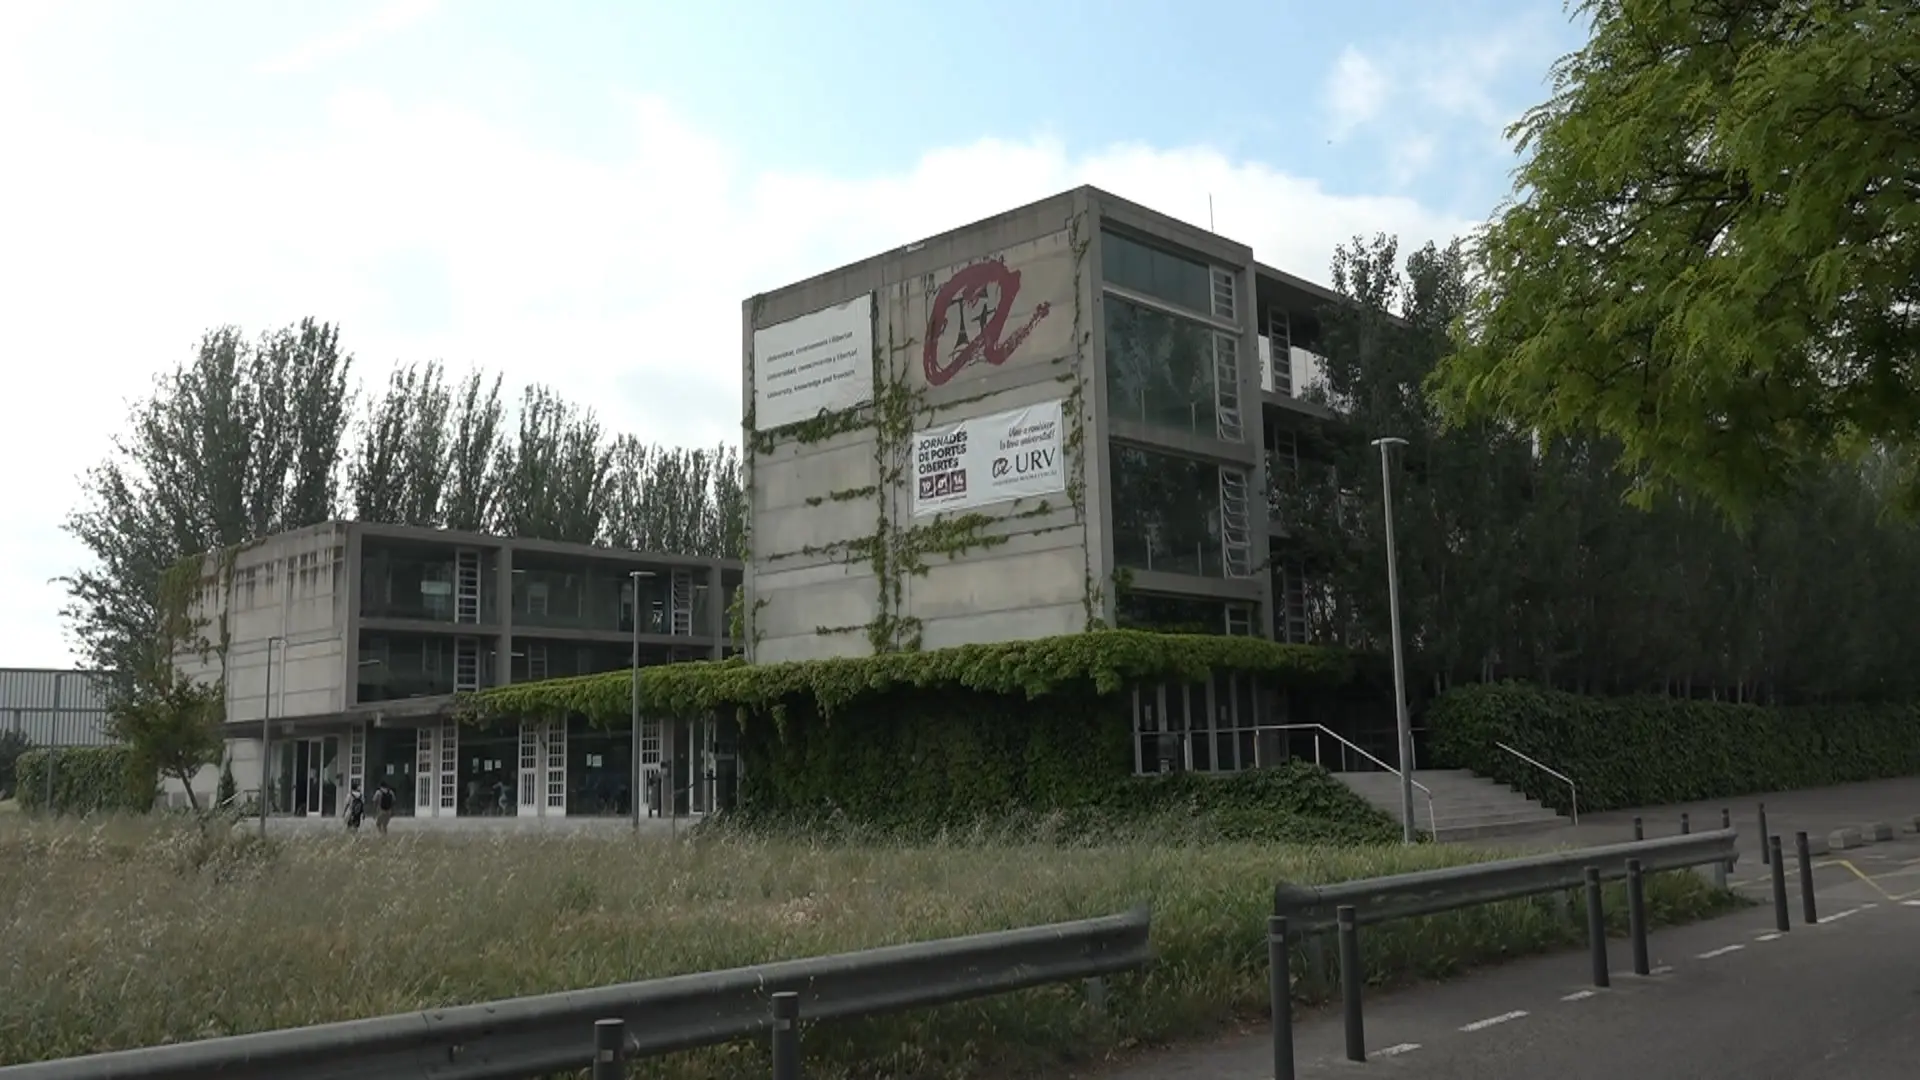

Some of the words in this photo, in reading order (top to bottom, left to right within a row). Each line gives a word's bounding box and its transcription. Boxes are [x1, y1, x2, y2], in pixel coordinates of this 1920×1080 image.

[919, 431, 968, 451] JORNADES
[919, 451, 930, 462] DE
[931, 444, 967, 460] PORTES
[1015, 447, 1056, 473] URV
[919, 457, 959, 475] OBERTES
